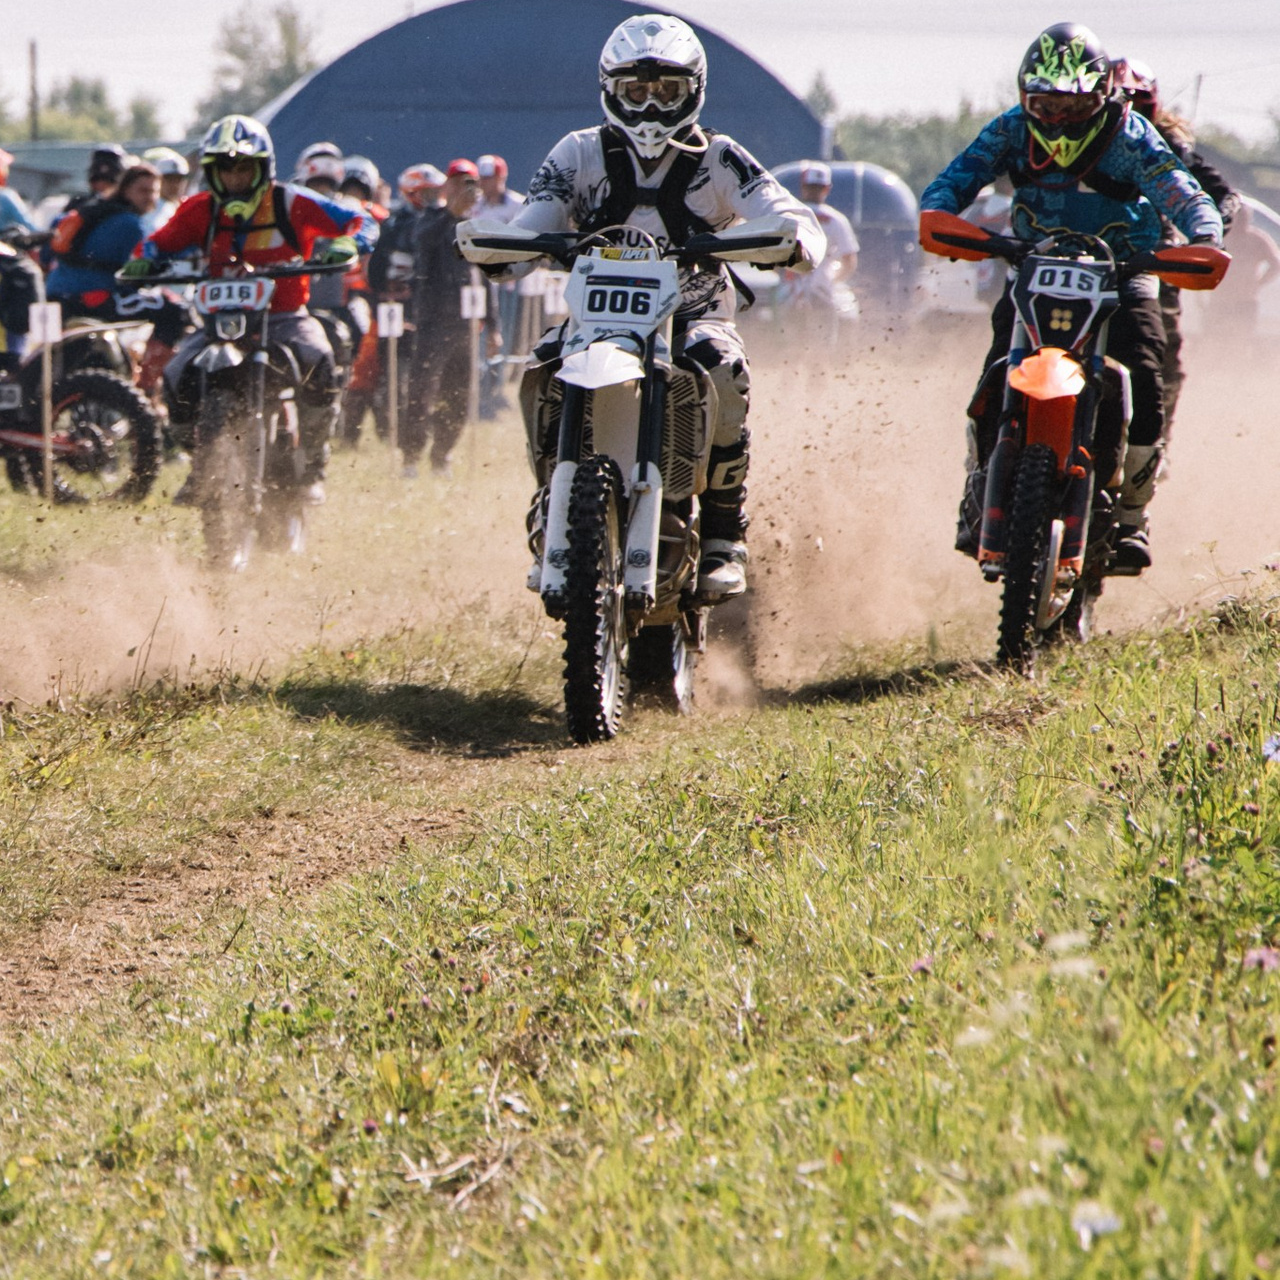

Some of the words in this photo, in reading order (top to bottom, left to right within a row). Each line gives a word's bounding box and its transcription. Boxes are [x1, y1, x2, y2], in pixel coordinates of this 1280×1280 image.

[209, 284, 252, 301] 016
[1038, 268, 1095, 293] 015
[587, 288, 652, 316] 006
